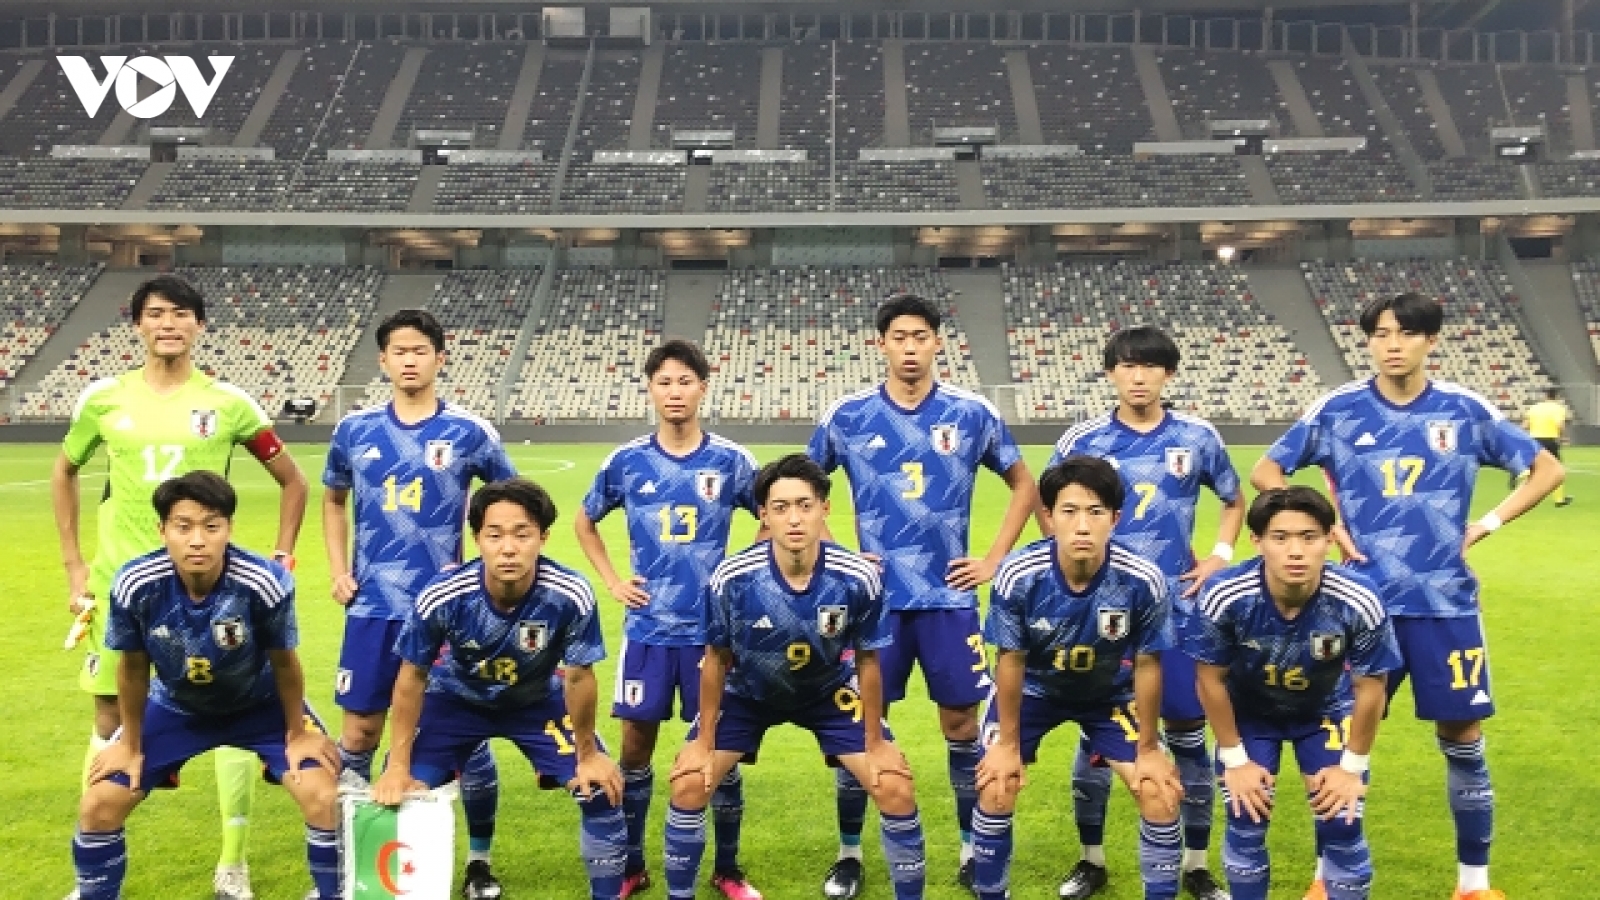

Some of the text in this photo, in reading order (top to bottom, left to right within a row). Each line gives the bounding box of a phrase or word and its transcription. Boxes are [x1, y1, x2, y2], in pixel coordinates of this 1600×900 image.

[382, 475, 423, 513] 14
[901, 462, 925, 499] 3
[1380, 457, 1425, 497] 17
[1133, 483, 1156, 519] 7
[659, 505, 698, 543] 13
[185, 655, 214, 684] 8
[786, 642, 812, 671] 9
[966, 634, 987, 673] 3
[1052, 645, 1096, 671] 10
[1447, 647, 1484, 690] 17
[1264, 663, 1310, 690] 16
[834, 687, 863, 723] 9
